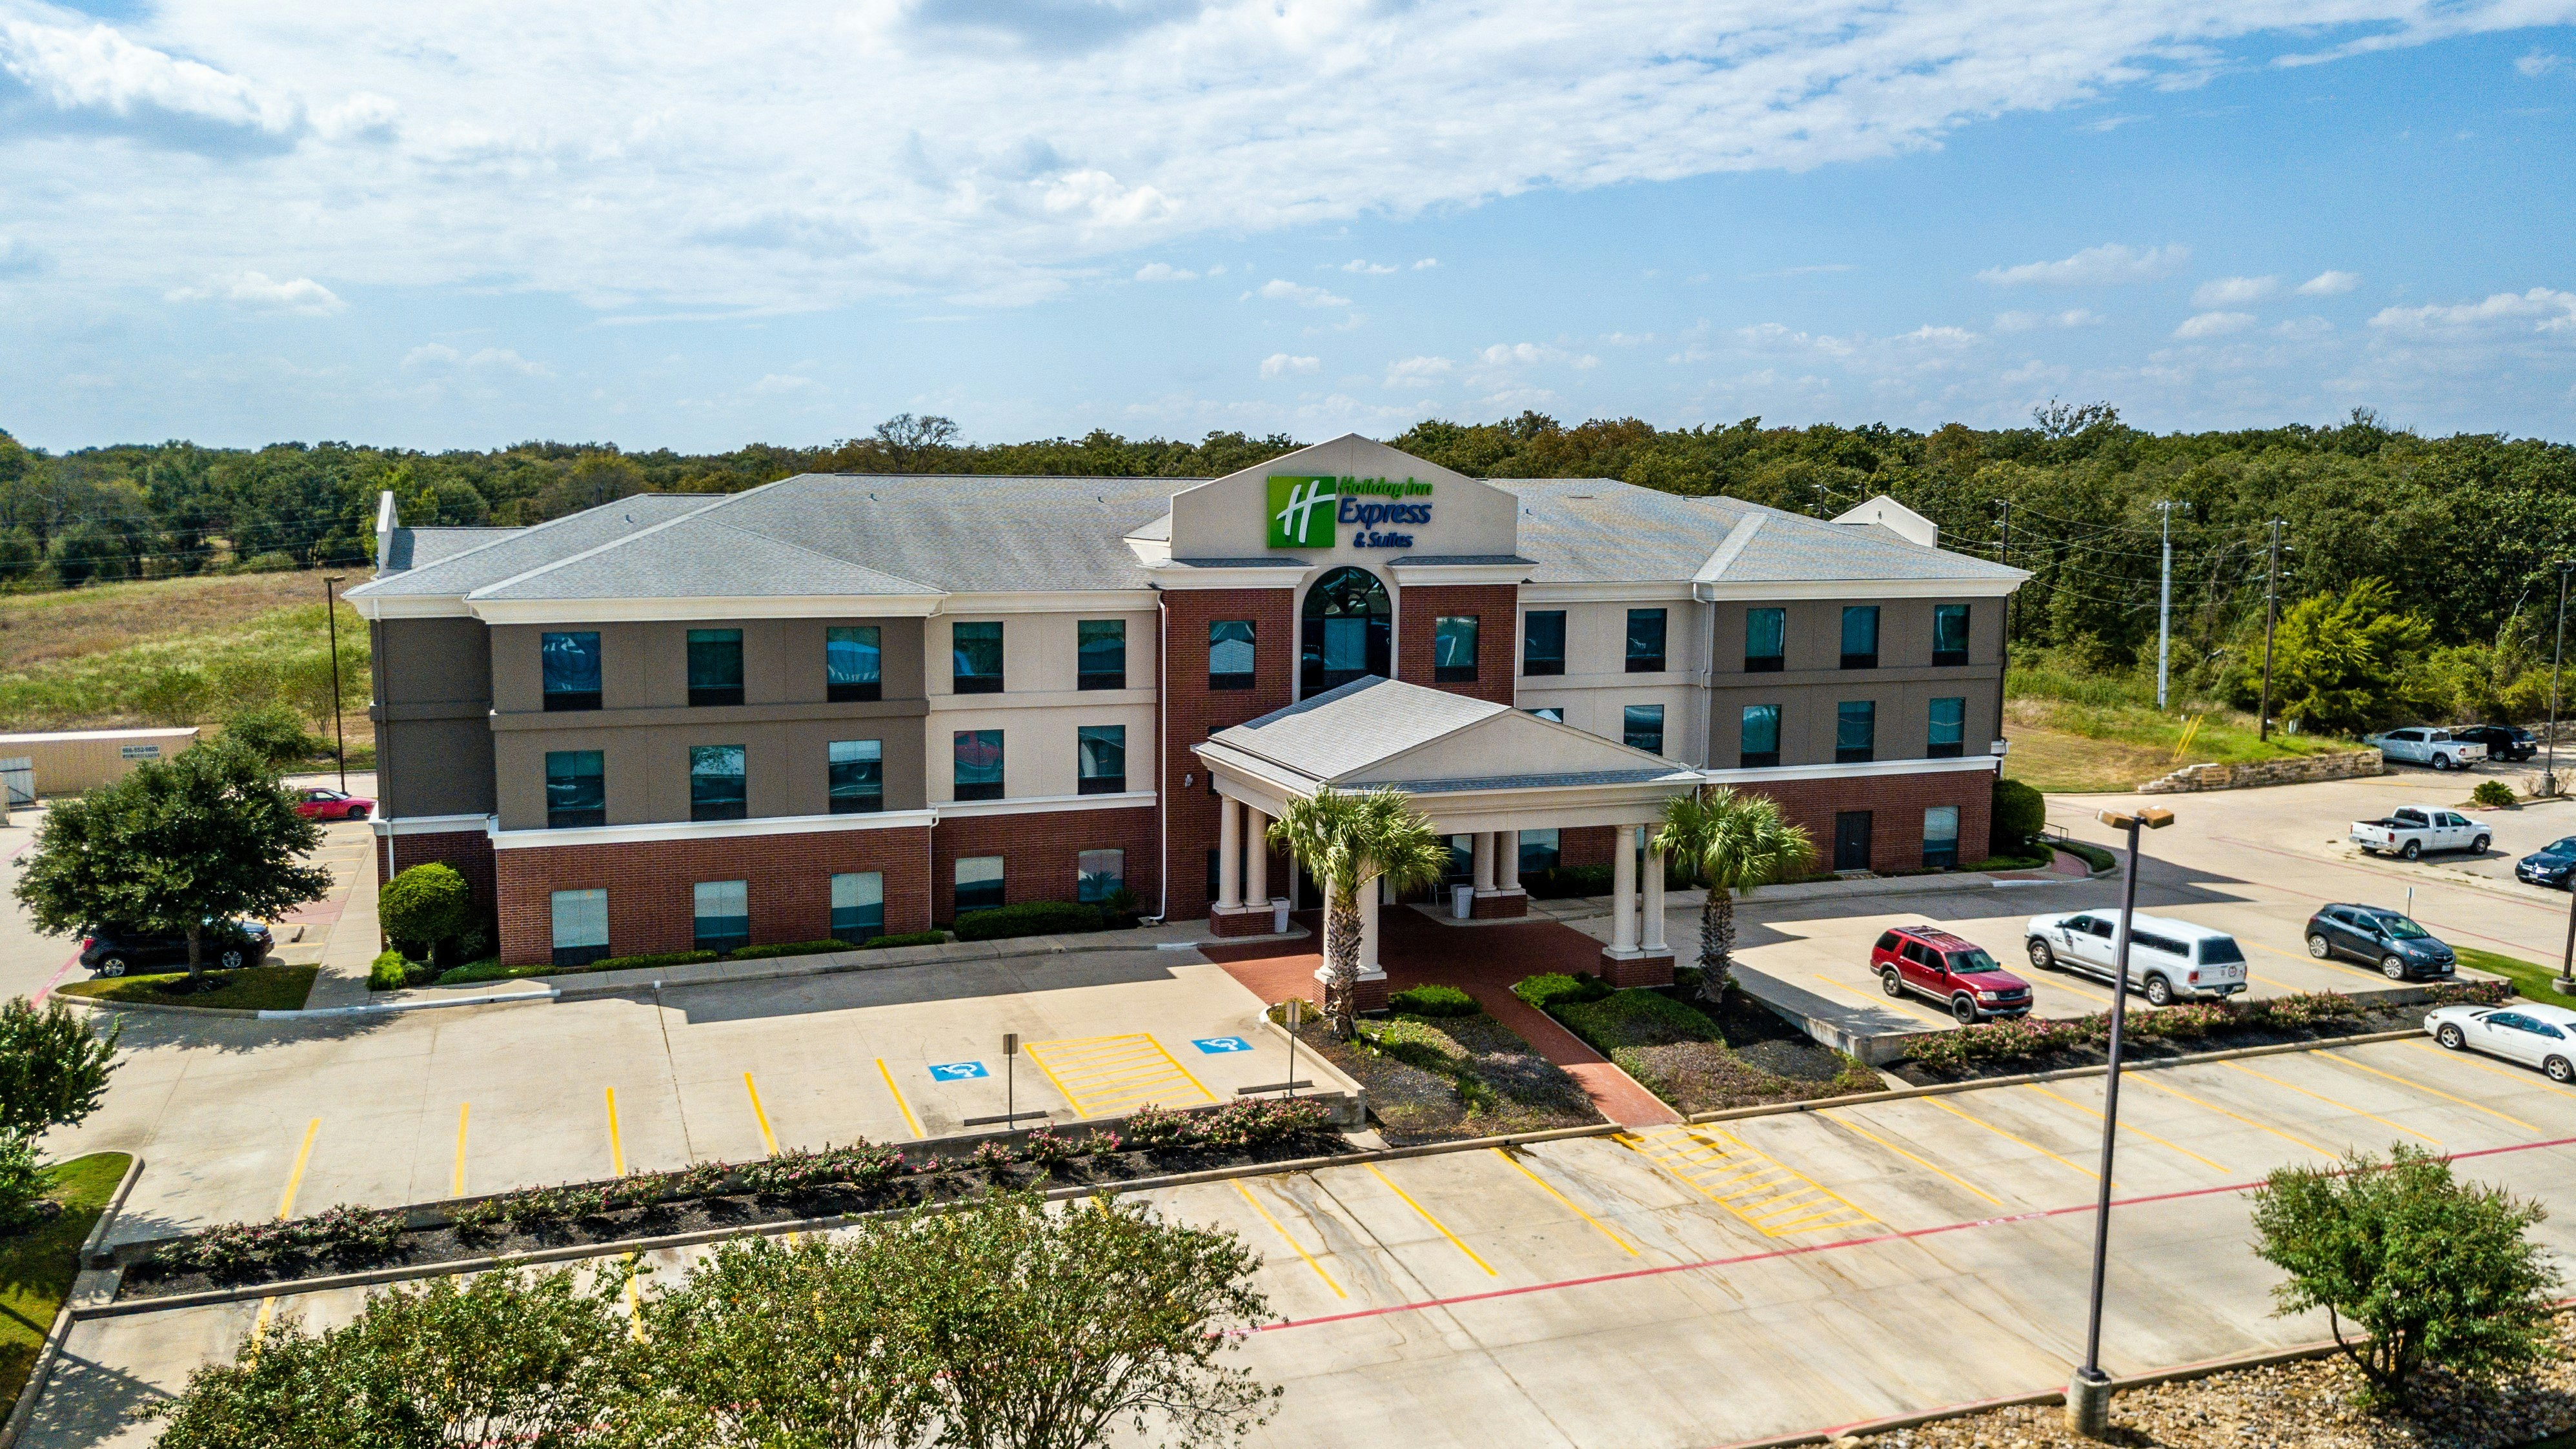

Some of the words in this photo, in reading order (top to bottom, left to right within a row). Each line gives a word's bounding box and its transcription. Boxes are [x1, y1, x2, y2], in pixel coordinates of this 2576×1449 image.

[1338, 476, 1405, 500] Holiday
[1405, 476, 1433, 496] Inn
[1338, 498, 1432, 530] Express
[1354, 532, 1366, 548] &
[1367, 532, 1414, 548] Suites
